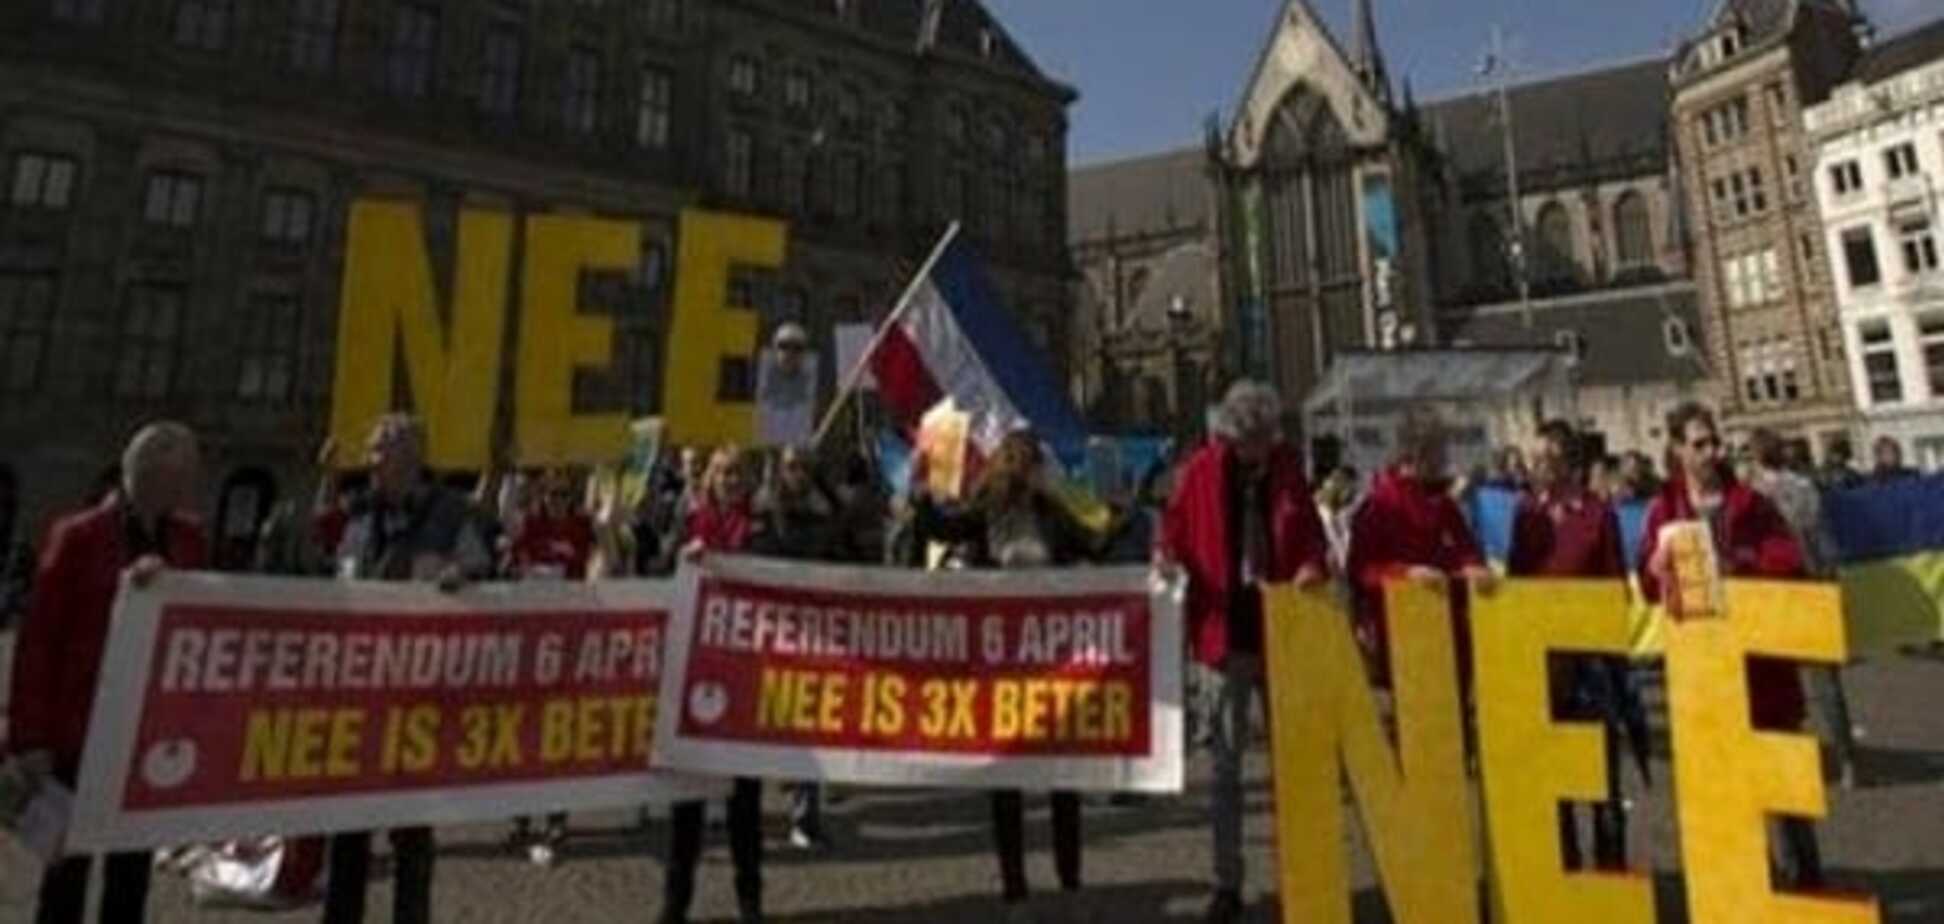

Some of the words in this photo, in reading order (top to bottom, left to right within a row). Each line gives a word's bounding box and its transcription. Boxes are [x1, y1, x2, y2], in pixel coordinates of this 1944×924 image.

[335, 200, 788, 471] NEE
[160, 626, 521, 692] REFERENDUM
[534, 632, 563, 684] 6
[574, 627, 660, 682] APR
[701, 597, 968, 662] REFERENDUM
[981, 615, 1001, 661] 6
[1017, 609, 1134, 667] APRIL
[238, 708, 363, 782] NEE
[380, 705, 441, 773] IS
[456, 700, 526, 768] 3X
[540, 694, 658, 763] BETE
[756, 667, 844, 730] NEE
[861, 672, 907, 734] IS
[919, 678, 978, 738] 3X
[992, 679, 1131, 740] BETER
[1262, 577, 1884, 924] NEE
